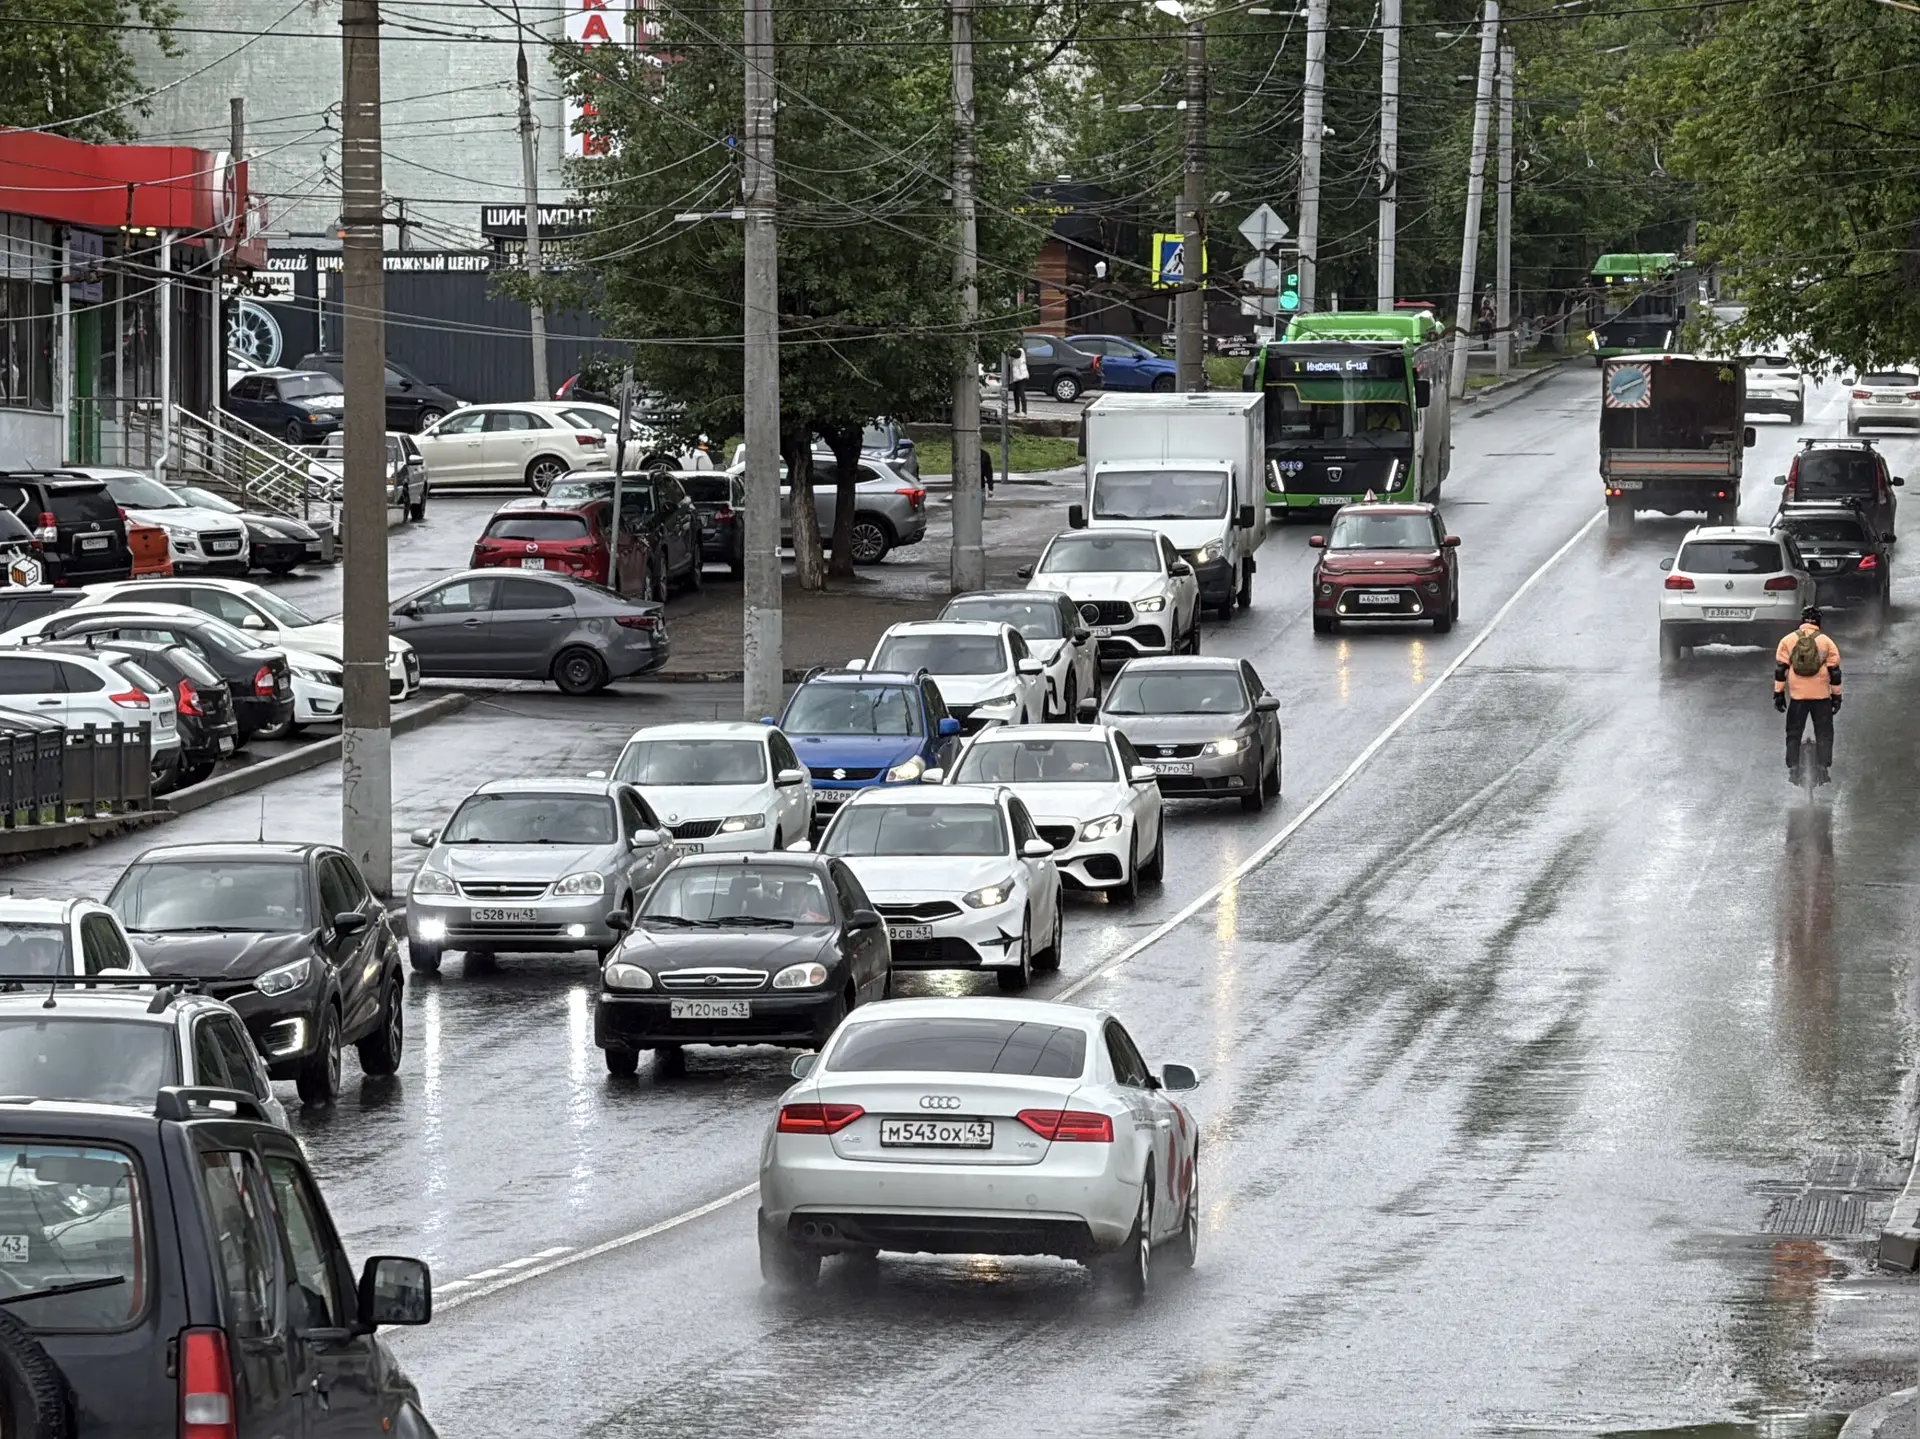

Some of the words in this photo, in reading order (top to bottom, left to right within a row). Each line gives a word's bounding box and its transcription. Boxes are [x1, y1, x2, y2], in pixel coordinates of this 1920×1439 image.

[448, 255, 490, 271] ЦЕНТР
[1287, 274, 1298, 286] 12
[1294, 362, 1301, 372] 1
[689, 844, 699, 853] 43
[475, 909, 520, 920] С528УН
[522, 908, 534, 918] 43
[916, 926, 928, 936] 43
[674, 1003, 728, 1017] У120МВ
[731, 1002, 745, 1013] 43
[888, 1123, 963, 1142] М543ОХ
[967, 1123, 986, 1138] 43
[1, 1236, 22, 1252] 43
